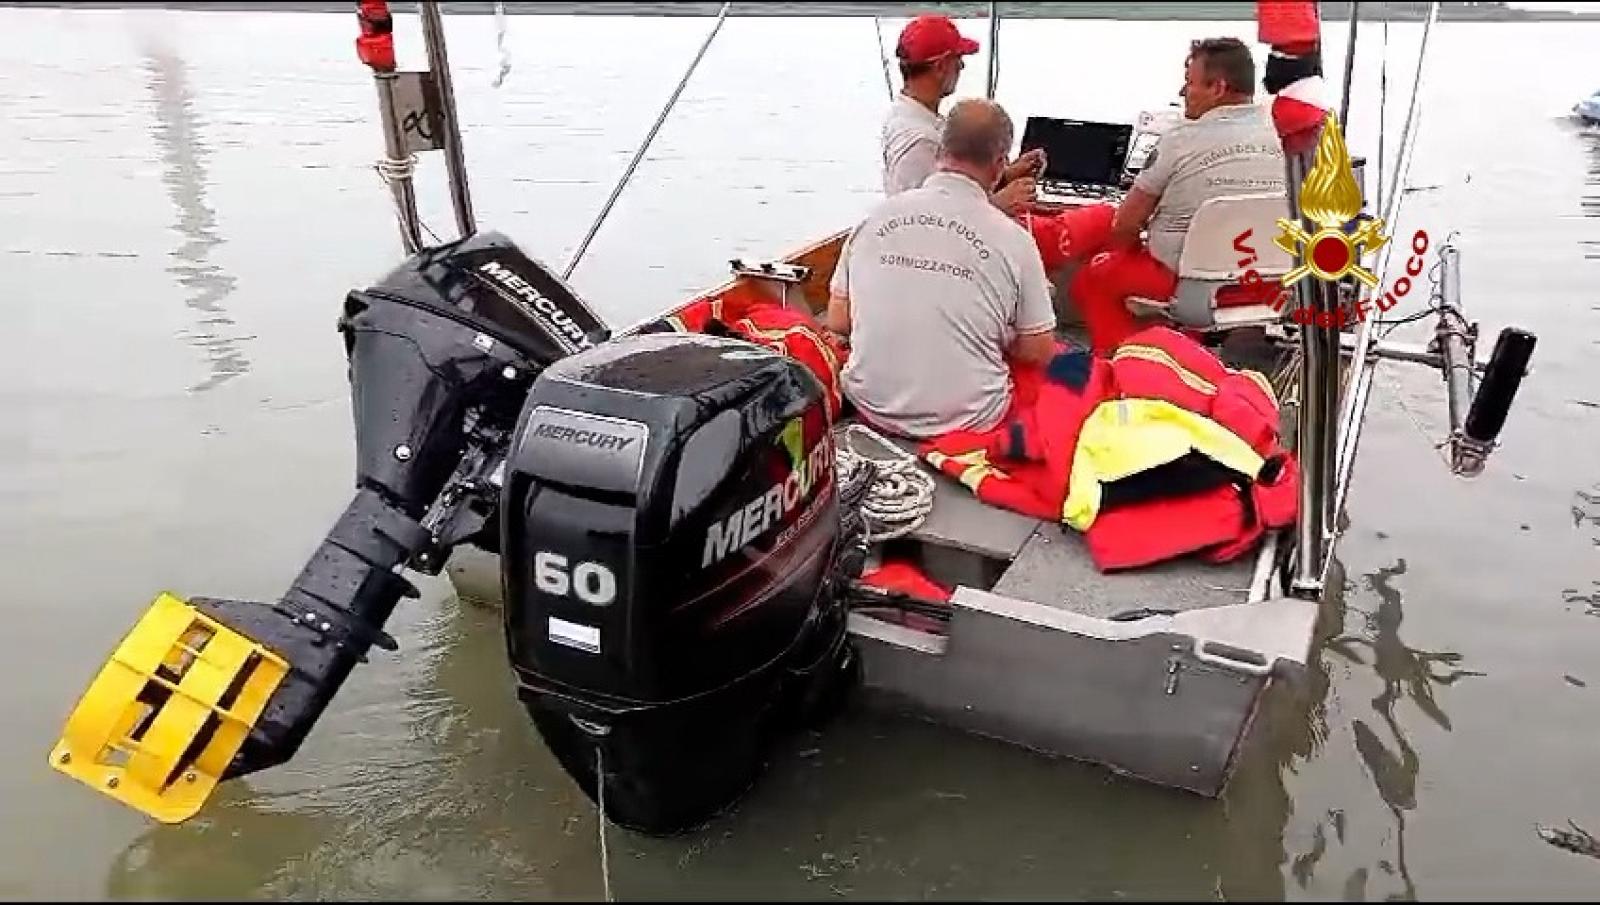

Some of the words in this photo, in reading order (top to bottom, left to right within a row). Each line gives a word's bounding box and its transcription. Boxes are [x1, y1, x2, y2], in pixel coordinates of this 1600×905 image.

[877, 216, 914, 238] VIGILI
[918, 214, 945, 228] DEL
[948, 220, 990, 260] FUOCO
[480, 261, 593, 352] MERCURY
[534, 423, 635, 451] MERCURY
[534, 550, 617, 607] 60
